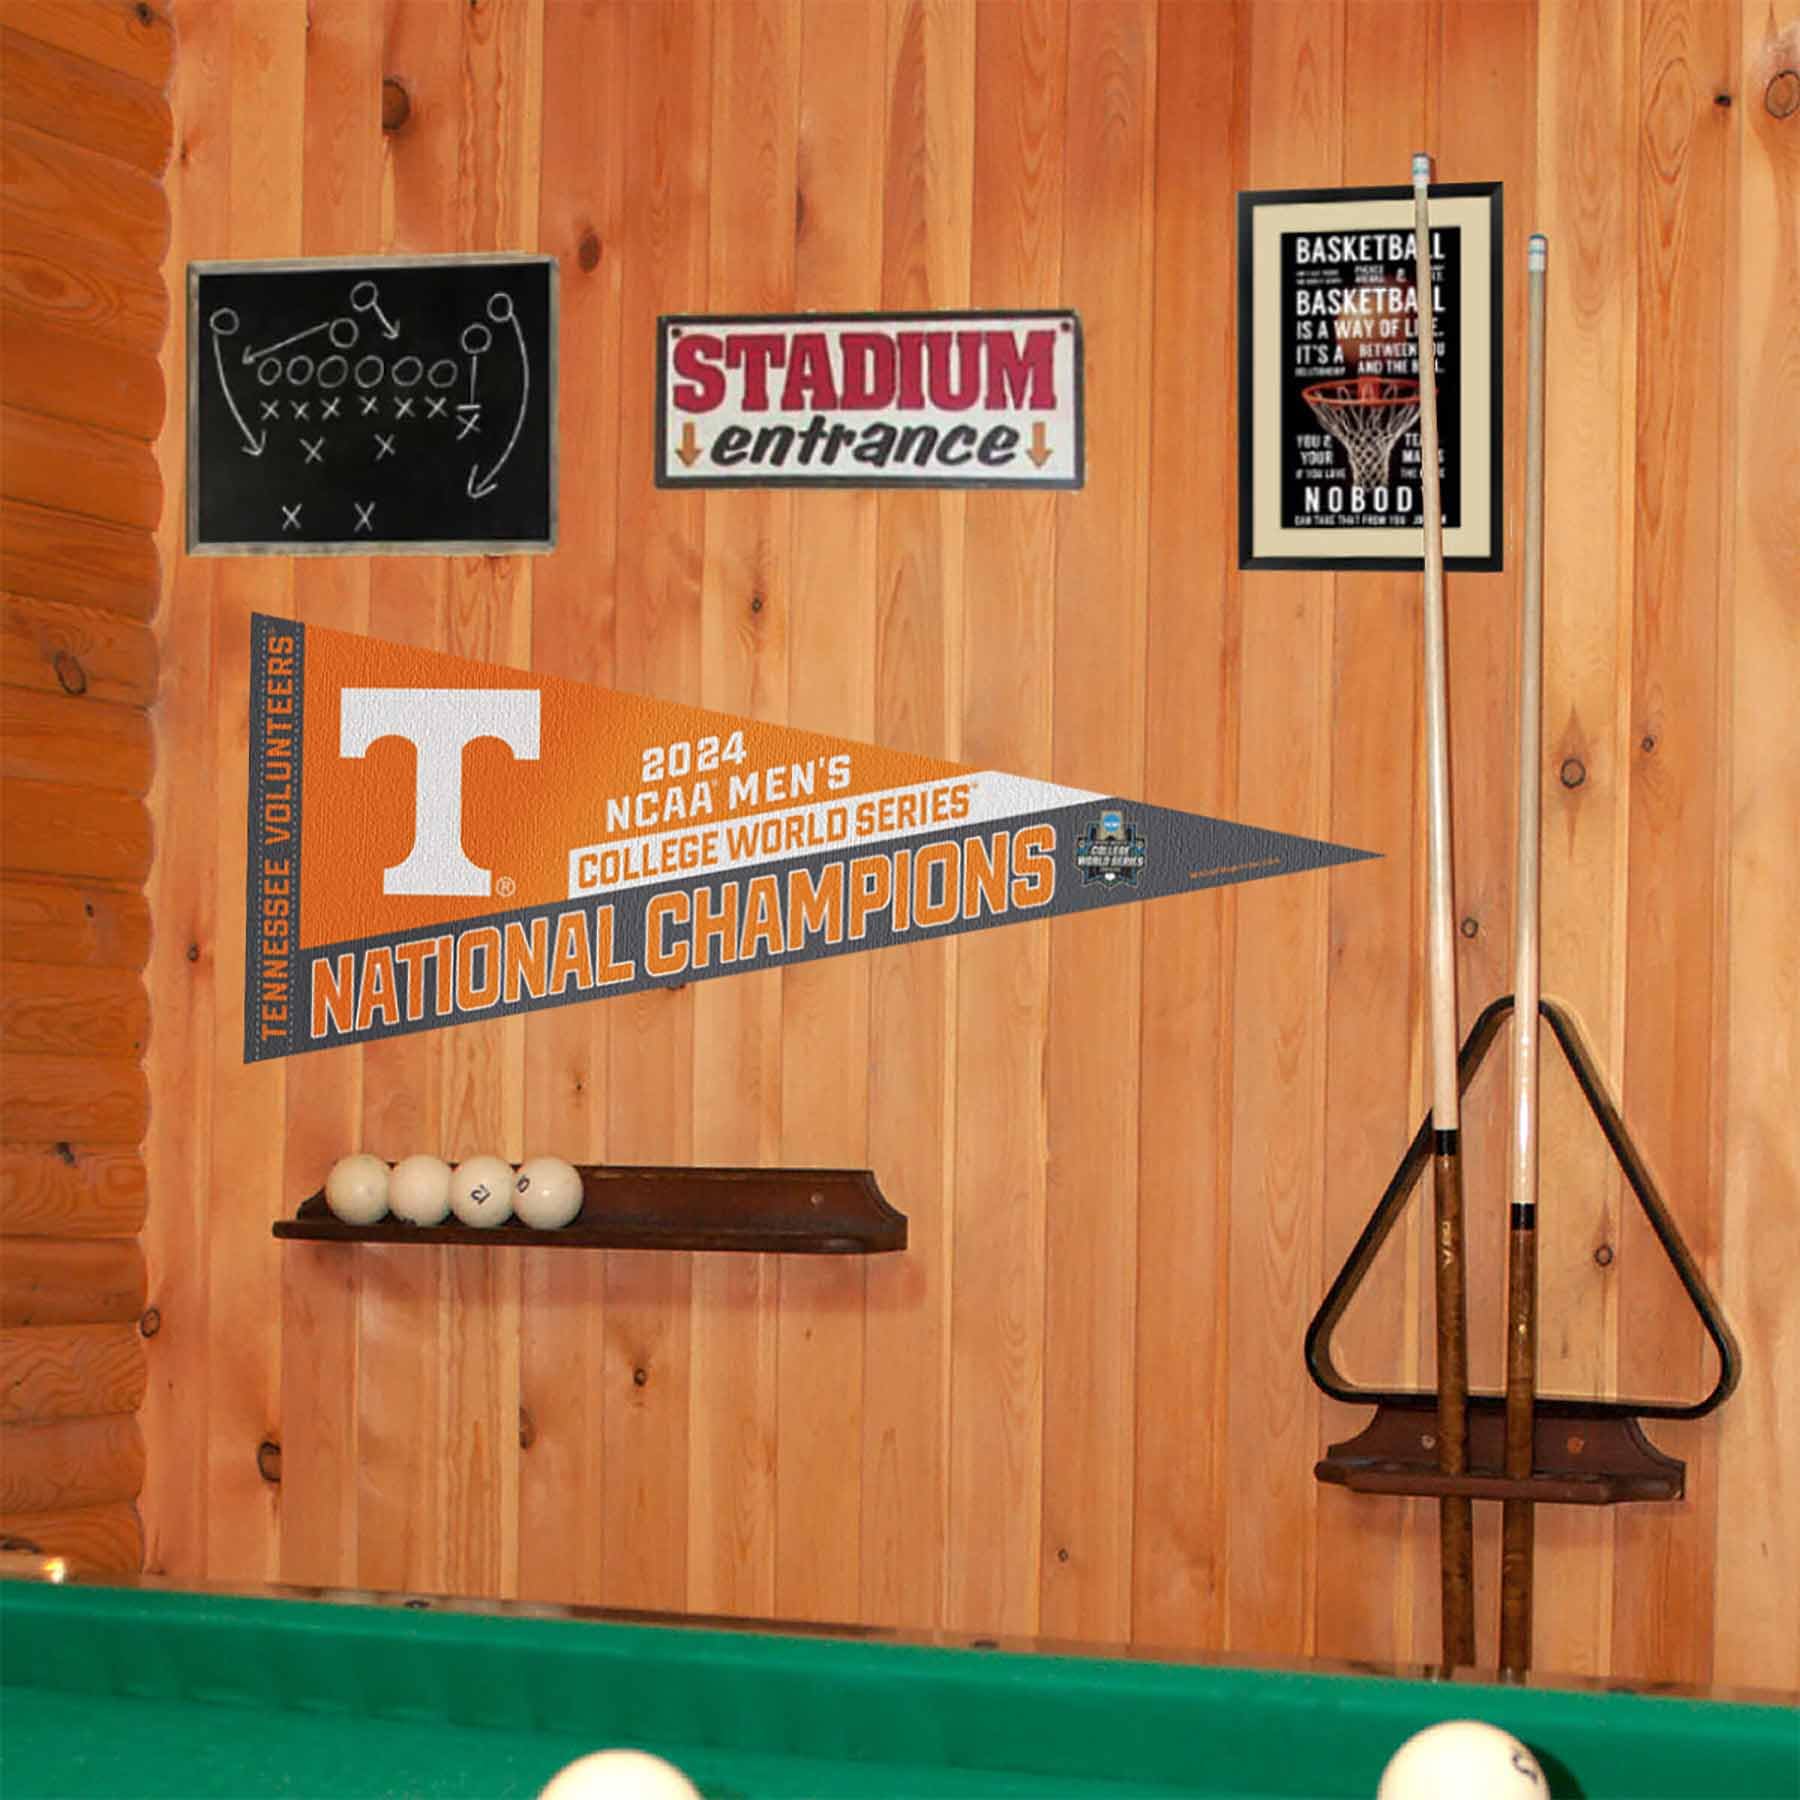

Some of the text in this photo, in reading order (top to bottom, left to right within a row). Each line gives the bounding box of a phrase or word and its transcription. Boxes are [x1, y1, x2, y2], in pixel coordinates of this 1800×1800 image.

[1296, 233, 1445, 264] BASKETBAL
[1296, 285, 1445, 316] BASKETBAL
[1296, 343, 1344, 365] IT'S A
[1297, 320, 1313, 340] IS
[1317, 320, 1329, 339] A
[1334, 319, 1375, 339] WAY
[1379, 318, 1400, 338] OF
[672, 330, 1057, 413] STADIUM
[1358, 359, 1382, 375] AND
[1386, 359, 1407, 374] THE
[711, 415, 1020, 467] entrance
[1300, 450, 1333, 466] YOUR
[641, 731, 748, 783] 2024
[340, 688, 541, 896] T
[606, 755, 850, 833] NCAA MEN'S
[261, 635, 294, 1041] TENNESSEE VOLUNTEERS
[578, 783, 971, 889] COLLEGE WORLD SERIES
[310, 824, 1057, 1039] NATIONAL CHAMPIONS
